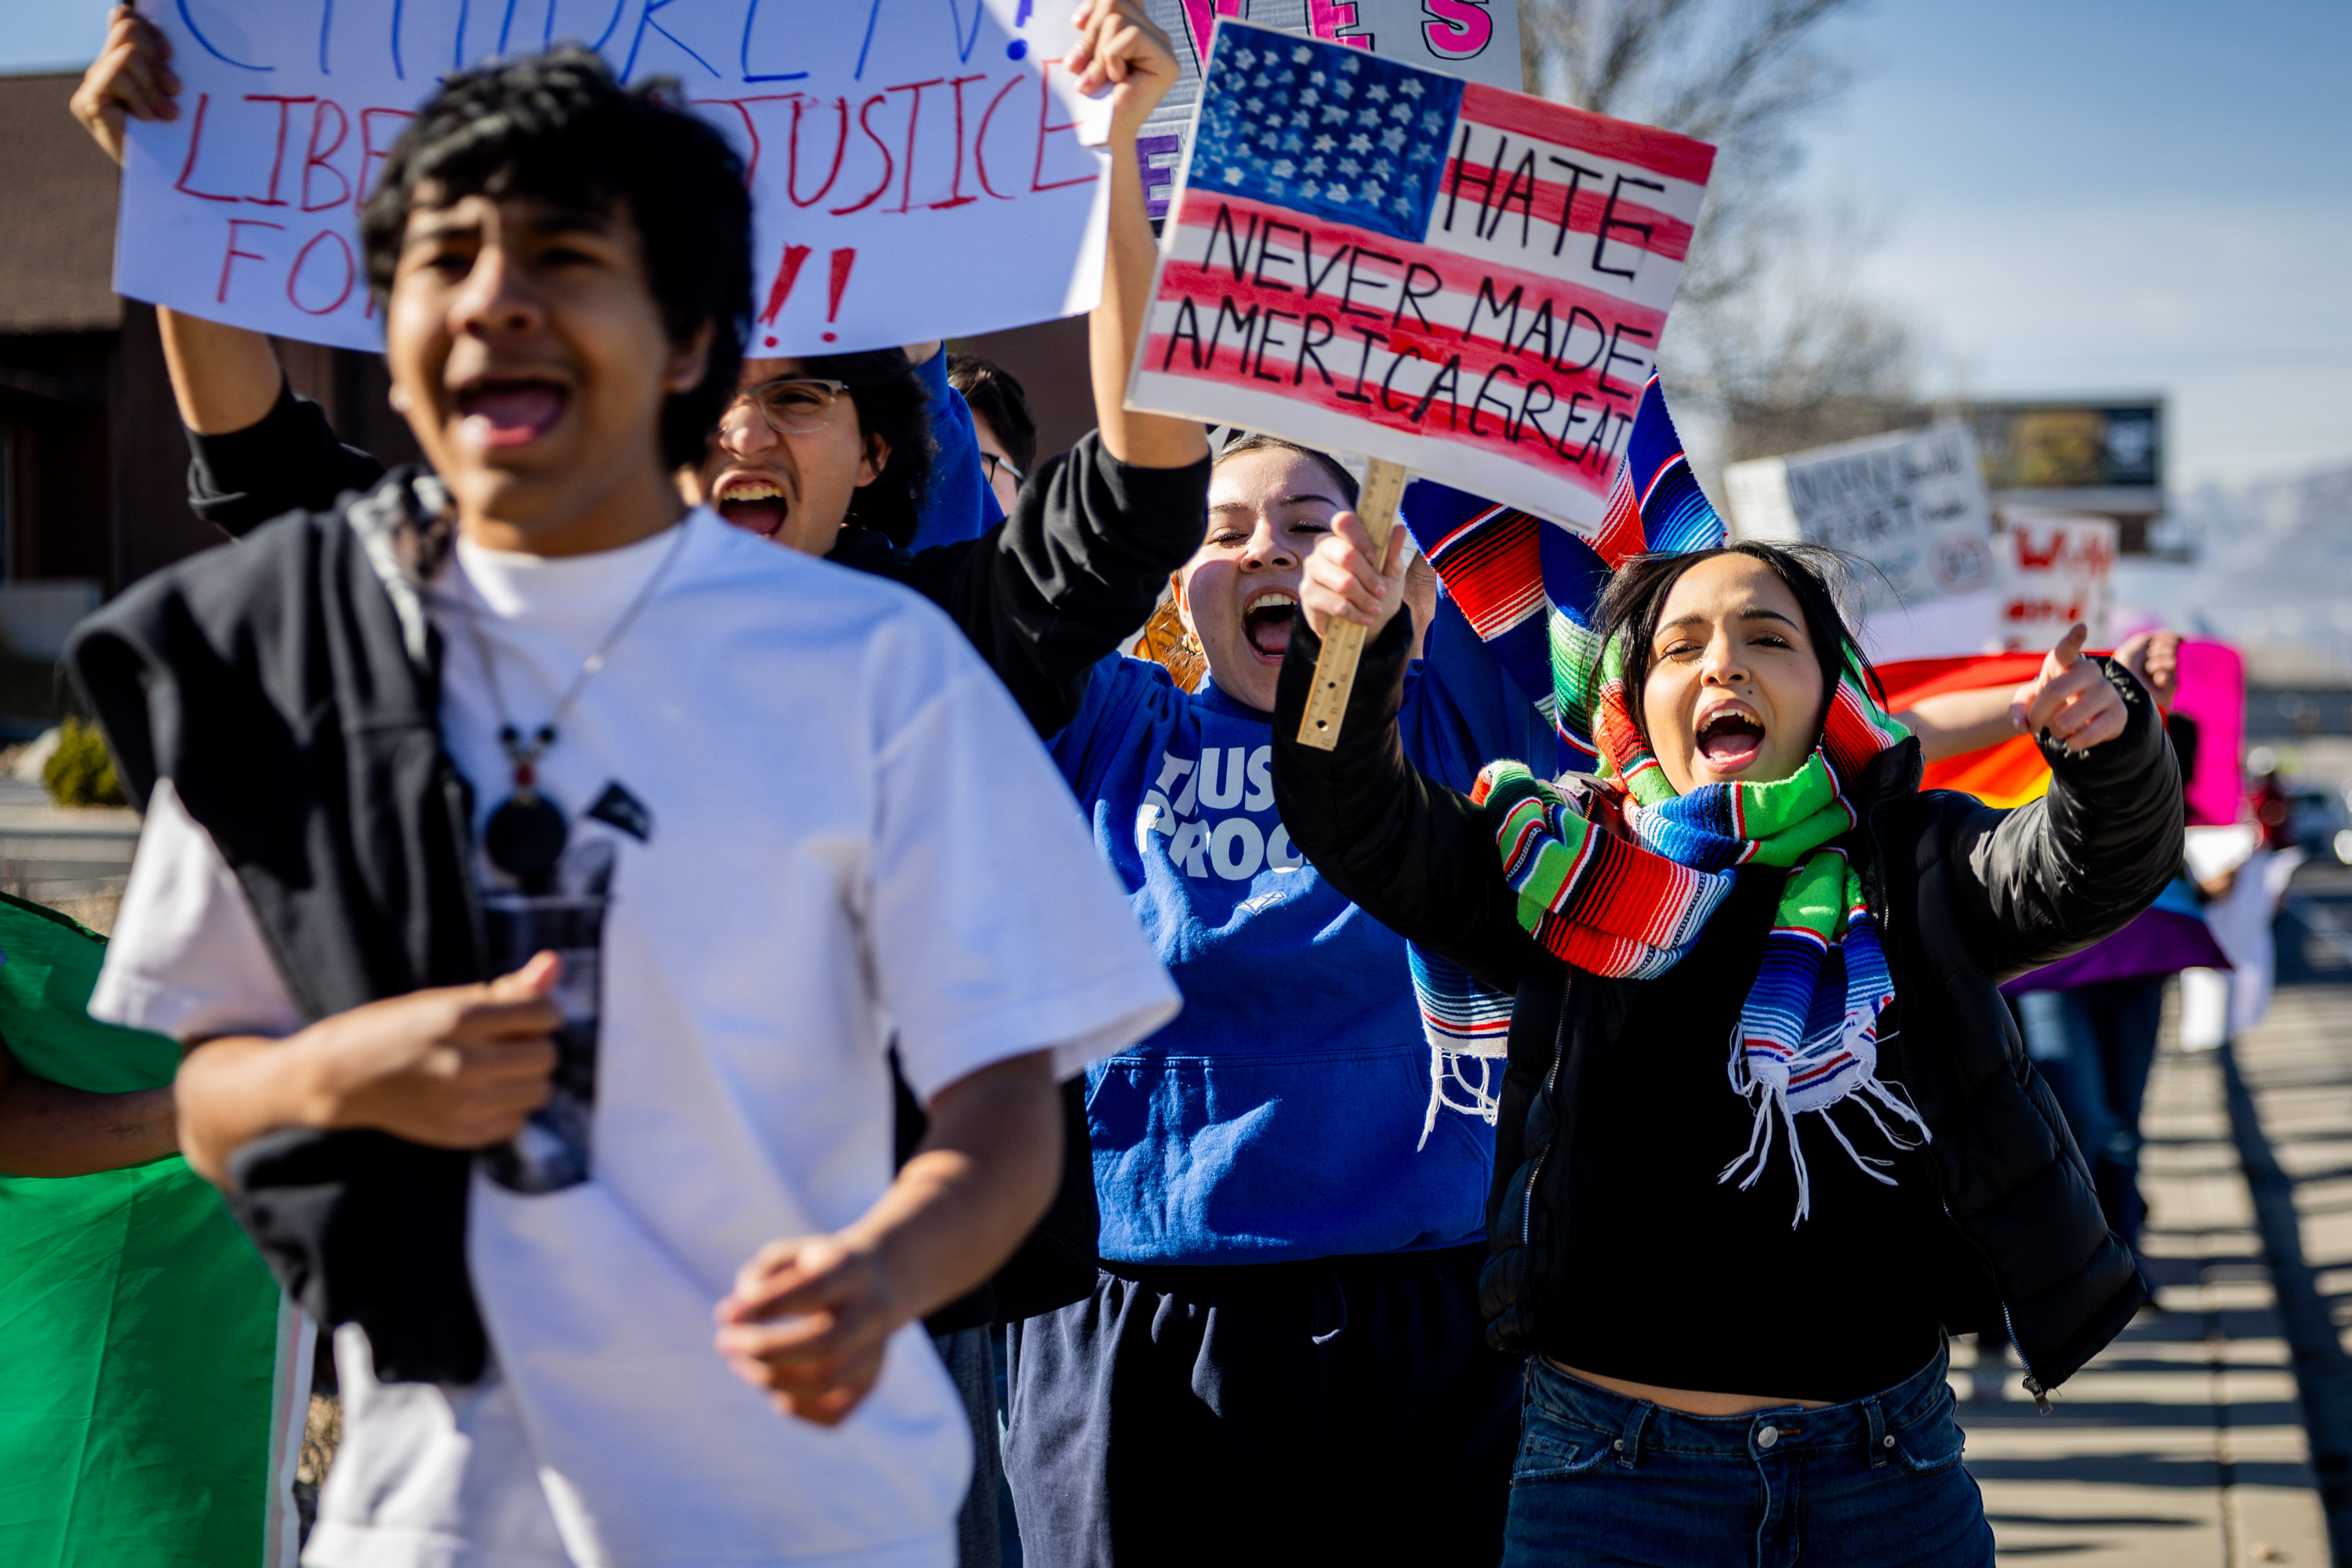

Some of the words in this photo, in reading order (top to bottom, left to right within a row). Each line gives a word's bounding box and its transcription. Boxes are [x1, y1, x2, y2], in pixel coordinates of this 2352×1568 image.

[690, 57, 1100, 216] JUSTICE
[1443, 124, 1665, 283] HATE
[215, 218, 378, 320] FO
[1200, 202, 1443, 332] NEVER
[1461, 276, 1653, 401] MADE
